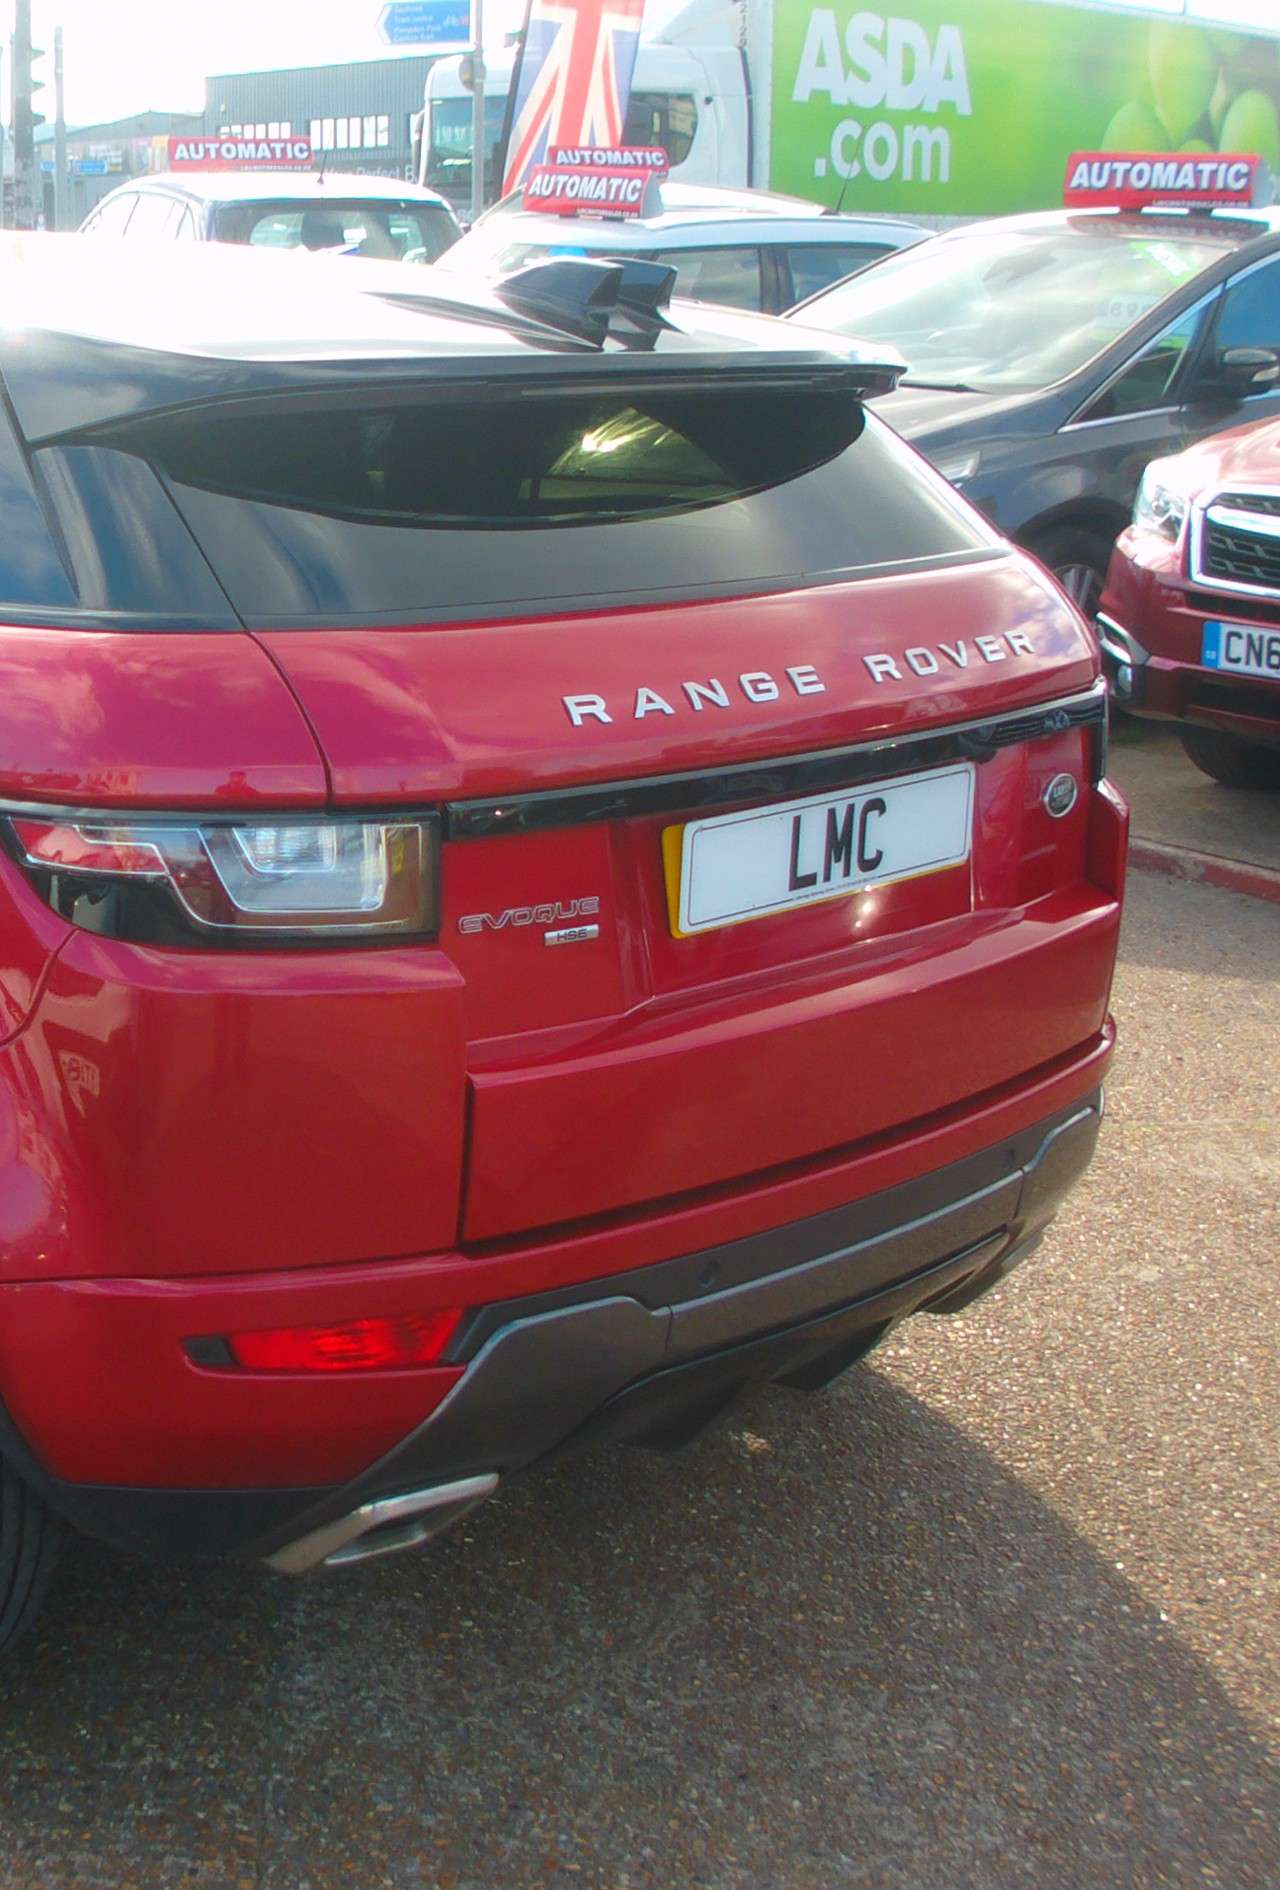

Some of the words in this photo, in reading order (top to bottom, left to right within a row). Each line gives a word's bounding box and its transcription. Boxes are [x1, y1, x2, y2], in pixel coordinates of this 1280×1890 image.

[791, 7, 973, 116] ASDA
[174, 141, 309, 161] AUTOMATIC
[556, 148, 665, 167] AUTOMATIC
[814, 118, 951, 183] .com
[528, 173, 644, 203] AUTOMATIC
[1070, 161, 1250, 191] AUTOMATIC
[1225, 630, 1280, 670] CN6
[562, 664, 826, 727] RANGE
[862, 629, 1037, 683] ROVER
[788, 797, 887, 892] LMC
[458, 896, 600, 935] EVOQUE
[556, 928, 588, 942] HSE
